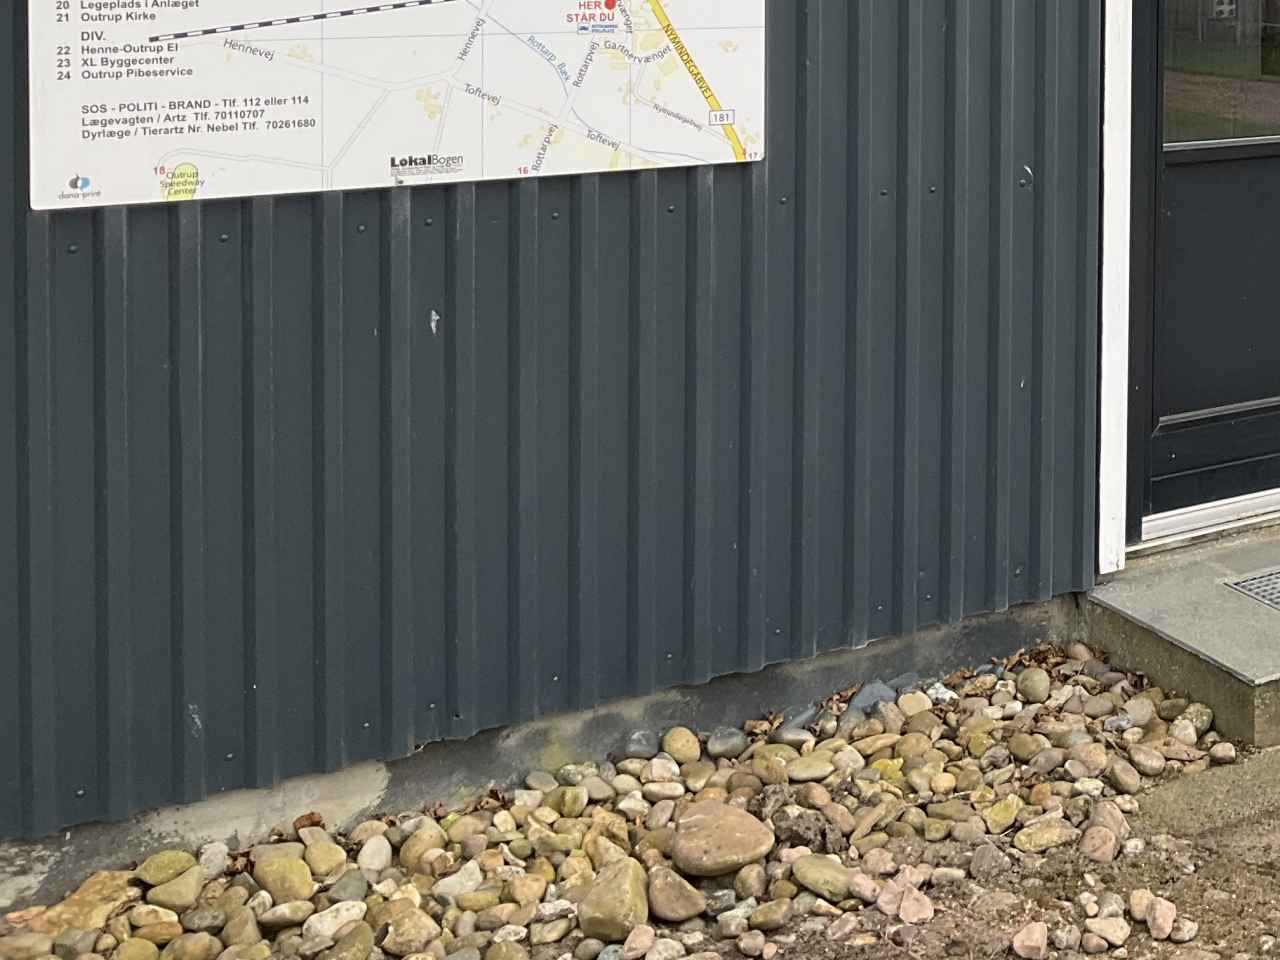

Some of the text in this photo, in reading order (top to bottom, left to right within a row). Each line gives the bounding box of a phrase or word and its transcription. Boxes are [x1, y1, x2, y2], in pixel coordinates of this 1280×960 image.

[56, 0, 199, 11] 20 Legeplads Anlæget
[578, 1, 602, 10] HER
[56, 12, 156, 23] 21 Outrup Kirke
[599, 12, 615, 22] DU
[81, 31, 106, 41] DIV.
[457, 16, 486, 62] Hennevej
[56, 43, 178, 55] 22 Henne-Outrup El
[223, 38, 275, 61] Hennevej
[603, 40, 672, 64] Gartnervænget
[56, 56, 175, 68] 23 XL Byggecenter
[572, 40, 600, 88] Rottarpvej
[663, 23, 713, 100] NYMINDEGABVEJ
[57, 68, 193, 81] 24 Outrup Pibeservice
[464, 83, 501, 106] Toftevej
[81, 96, 310, 114] SOS POLITI BRAND Tlf. 112 eller 114
[82, 110, 265, 127] Lægevagten Artz Tlf. 70110707
[713, 113, 730, 123] 181
[82, 128, 132, 141] Dyrlæge
[142, 125, 184, 136] Tierartz
[206, 122, 239, 133] Nebel
[265, 118, 316, 130] 70261680
[531, 123, 559, 172] Rottarpvej
[587, 129, 621, 151] Toftevej
[390, 154, 464, 168] LokalBogen
[517, 166, 529, 175] 16
